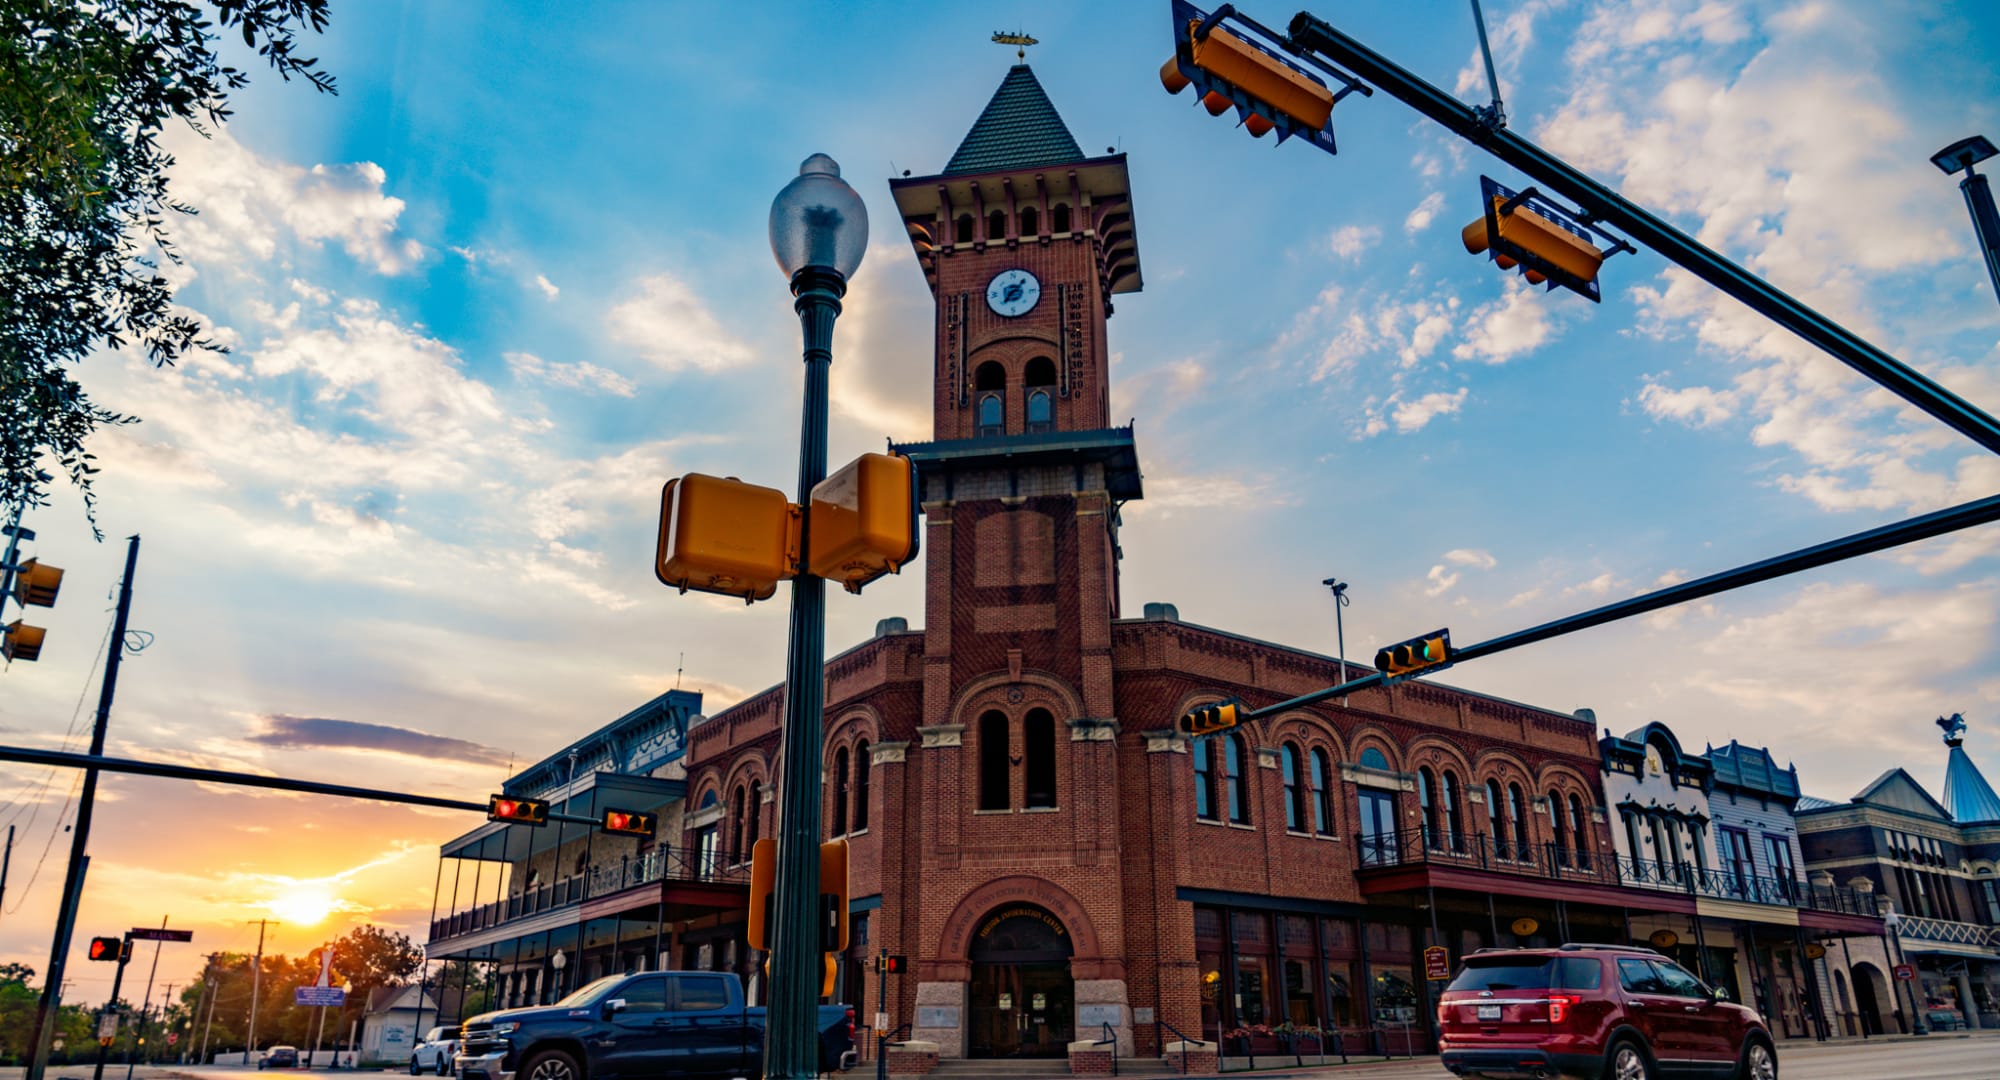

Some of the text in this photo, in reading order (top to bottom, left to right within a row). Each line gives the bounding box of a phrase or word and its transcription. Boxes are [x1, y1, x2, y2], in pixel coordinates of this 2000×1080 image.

[1010, 272, 1017, 280] N
[948, 295, 958, 304] 12
[1070, 302, 1081, 310] 90
[1071, 331, 1082, 339] 60
[1072, 350, 1082, 358] 40
[1072, 361, 1083, 369] 30
[1072, 371, 1083, 379] 20
[1073, 381, 1083, 389] 10
[975, 887, 1025, 909] CONVENTION
[979, 908, 1064, 938] VISITOR INFORMATION CENTER
